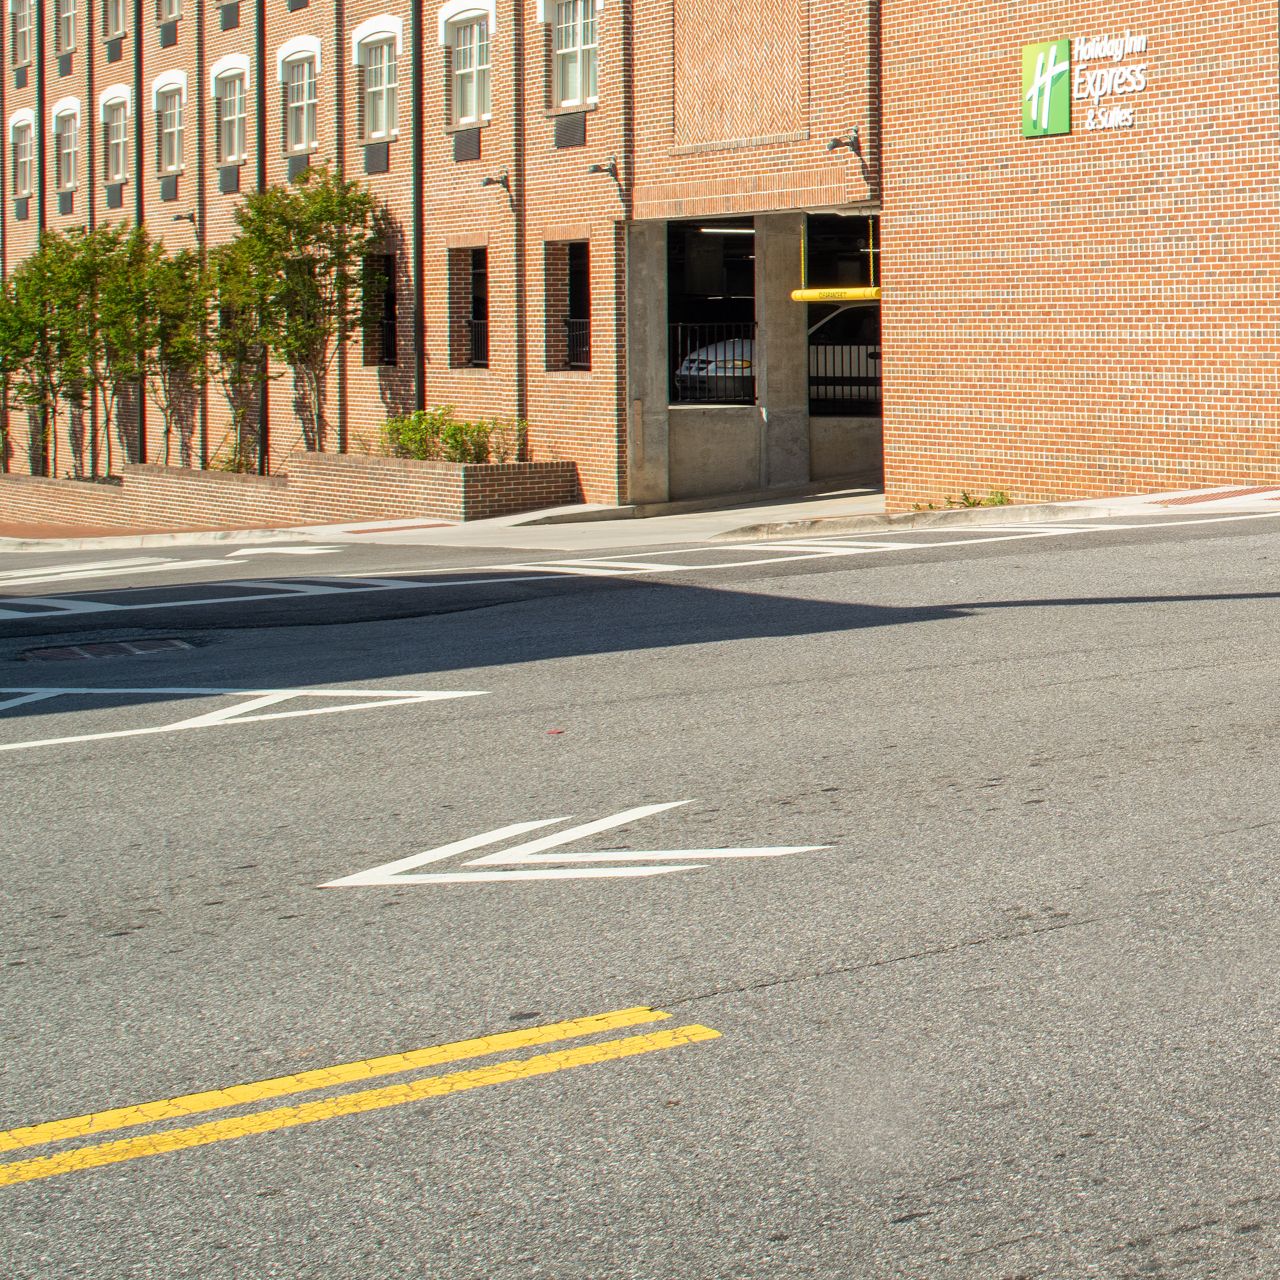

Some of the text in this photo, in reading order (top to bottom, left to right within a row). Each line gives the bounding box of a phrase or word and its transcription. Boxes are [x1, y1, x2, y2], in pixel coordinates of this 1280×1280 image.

[1074, 29, 1147, 62] Holiday Inn
[1074, 64, 1147, 106] Express
[1086, 107, 1134, 131] & Suites
